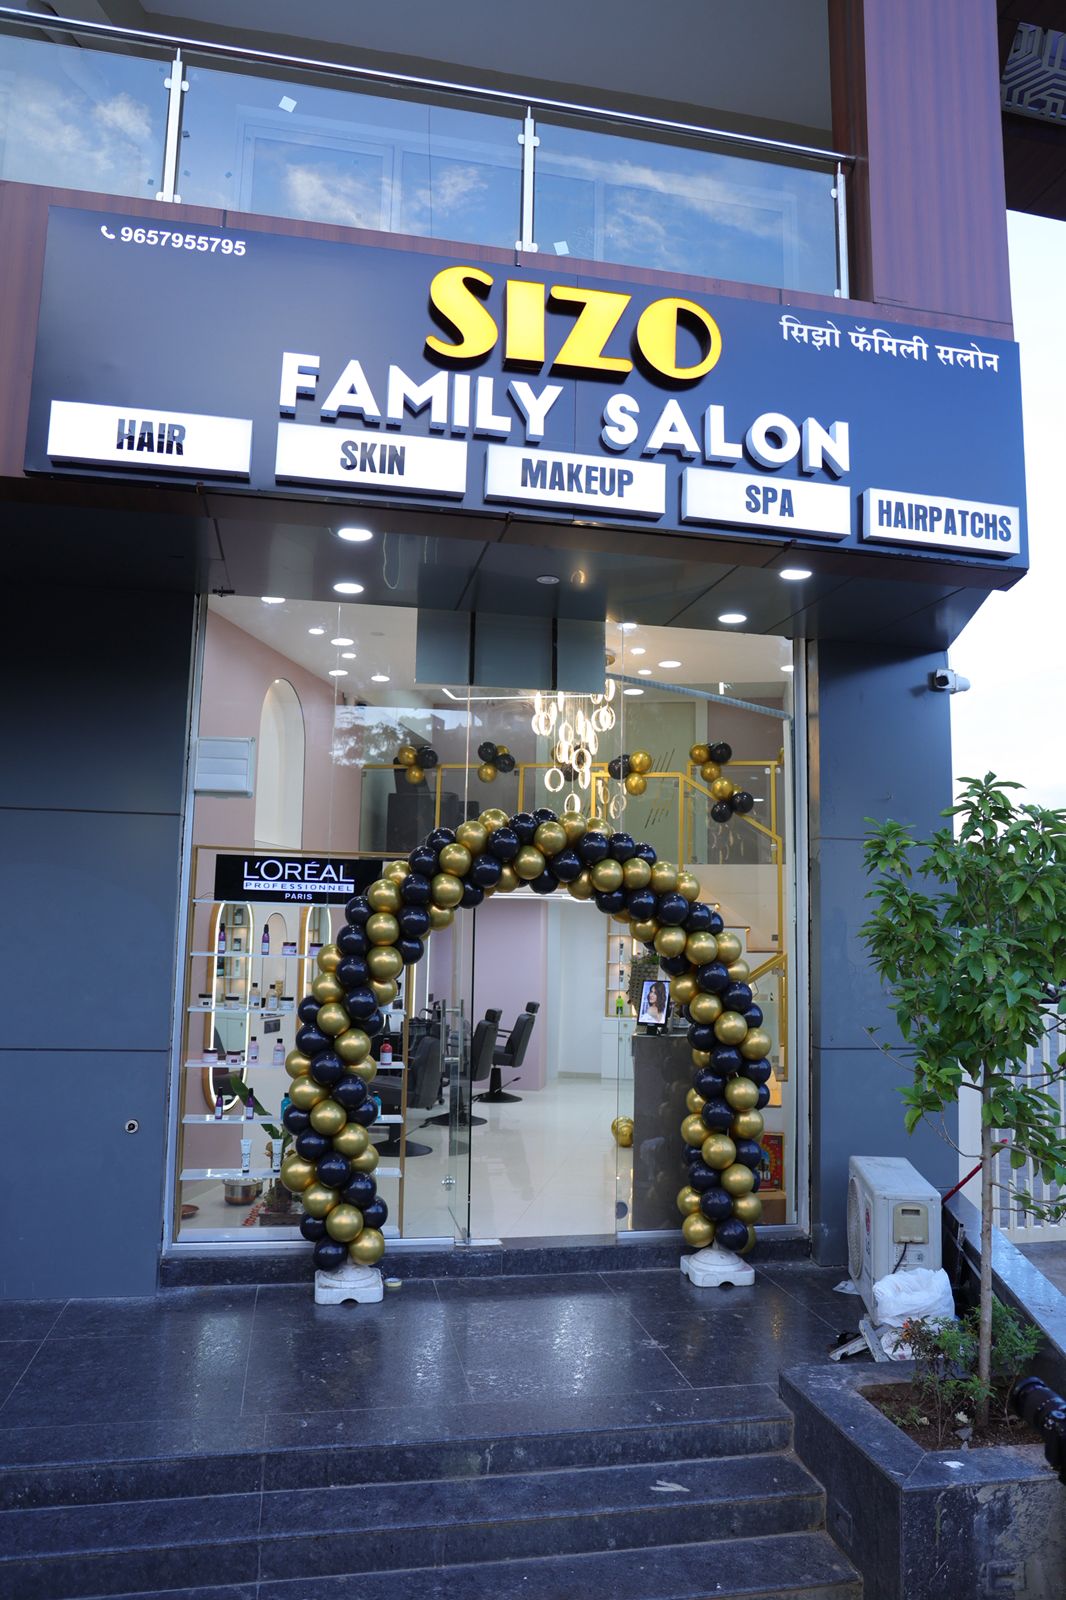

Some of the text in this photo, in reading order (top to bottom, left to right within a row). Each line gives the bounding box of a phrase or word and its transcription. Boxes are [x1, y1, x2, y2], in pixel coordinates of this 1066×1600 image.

[120, 226, 246, 256] 9657955795
[424, 266, 722, 381] SIZO
[779, 315, 999, 373] सिझो फॅमिली सलोन
[280, 352, 850, 476] FAMILY SALON
[116, 418, 186, 456] HAIR
[340, 440, 406, 476] SKIN
[520, 458, 634, 498] MAKEUP
[745, 484, 795, 518] SPA
[877, 500, 1013, 542] HAIRPATCHS
[244, 882, 353, 892] PROFESSIONNEL
[285, 892, 313, 900] PARIS
